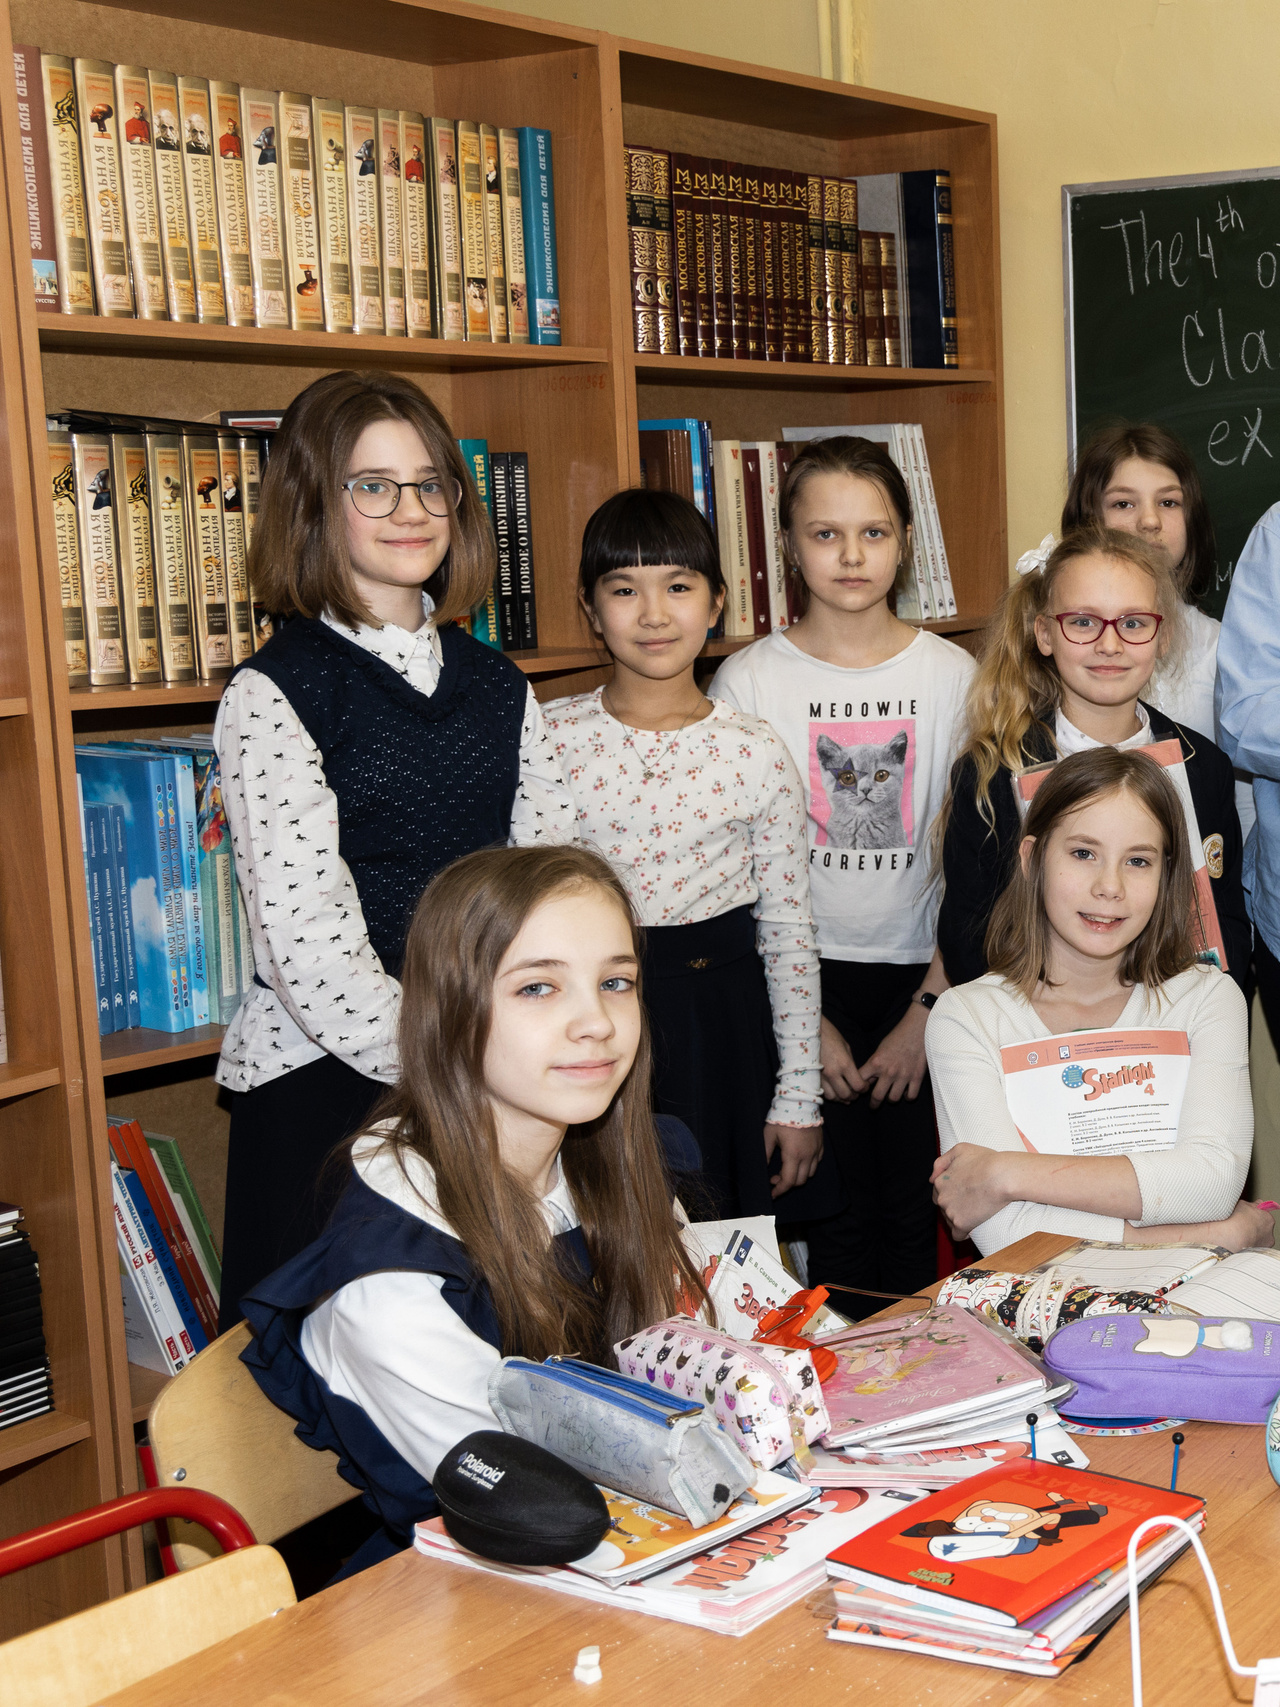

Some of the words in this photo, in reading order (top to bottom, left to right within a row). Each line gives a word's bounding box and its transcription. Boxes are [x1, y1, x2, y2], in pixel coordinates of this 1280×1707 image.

[13, 52, 28, 97] ДЕТЕЙ
[18, 102, 31, 131] ДЛЯ
[536, 135, 546, 171] ДЕТЕЙ
[22, 136, 42, 250] ЭНЦИКЛОПЕДИЯ
[58, 139, 75, 229] ШКОЛЬНАЯ
[95, 145, 112, 233] ШКОЛЬНАЯ
[131, 147, 147, 235] ШКОЛЬНАЯ
[161, 153, 177, 239] ШКОЛЬНАЯ
[191, 157, 207, 242] ШКОЛЬНАЯ
[223, 161, 239, 247] ШКОЛЬНАЯ
[538, 174, 548, 198] ДЛЯ
[256, 168, 270, 252] ШКОЛЬНАЯ
[301, 177, 315, 259] ШКОЛЬНАЯ
[324, 175, 340, 256] ШКОЛЬНАЯ
[356, 179, 370, 259] ШКОЛЬНАЯ
[385, 186, 396, 257] ШКОЛЬНАЯ
[408, 185, 420, 263] ШКОЛЬНАЯ
[442, 193, 454, 262] ШКОЛЬНАЯ
[475, 200, 485, 275] ШКОЛЬНАЯ
[488, 200, 499, 267] ШКОЛЬНАЯ
[515, 207, 524, 274] ШКОЛЬНАЯ
[541, 201, 555, 294] ЭНЦИКЛОПЕДИЯ
[676, 209, 689, 291] МОСКОВСКАЯ
[695, 213, 707, 294] МОСКОВСКАЯ
[712, 213, 724, 294] МОСКОВСКАЯ
[729, 215, 741, 295] МОСКОВСКАЯ
[745, 217, 756, 296] МОСКОВСКАЯ
[1100, 209, 1189, 295] The
[763, 221, 774, 299] МОСКОВСКАЯ
[780, 221, 791, 299] МОСКОВСКАЯ
[795, 223, 806, 300] МОСКОВСКАЯ
[473, 454, 487, 496] ДЕТЕЙ
[734, 478, 742, 508] МОСКВА
[494, 466, 508, 535] ПУШКИНЕ
[514, 465, 528, 534] ПУШКИНЕ
[56, 513, 72, 600] ШКОЛЬНАЯ
[90, 513, 107, 600] ШКОЛЬНАЯ
[132, 515, 147, 600] ШКОЛЬНАЯ
[163, 514, 179, 598] ШКОЛЬНАЯ
[200, 515, 216, 598] ШКОЛЬНАЯ
[227, 518, 241, 592] ШКОЛЬНАЯ
[499, 537, 509, 548] О
[518, 536, 528, 547] О
[736, 510, 745, 567] ПРАВОСЛАВНАЯ
[500, 550, 512, 596] НОВОЕ
[518, 548, 531, 594] НОВОЕ
[809, 699, 917, 718] MEOOWIE
[157, 828, 168, 852] МИРЕ
[159, 854, 169, 864] О
[167, 826, 177, 850] МИРЕ
[185, 821, 196, 853] Земля!
[809, 848, 915, 871] FOREVER
[91, 871, 102, 901] Пушкина
[103, 867, 114, 897] Пушкина
[118, 865, 129, 895] Пушкина
[161, 866, 172, 892] КНИГА
[171, 863, 181, 889] КНИГА
[188, 854, 198, 891] планете
[222, 858, 232, 917] ХУДОЖНИКИ
[163, 895, 176, 935] ГЛАВНАЯ
[173, 892, 185, 931] ГЛАВНАЯ
[191, 892, 199, 903] на
[191, 904, 202, 923] мир
[166, 936, 178, 968] САМАЯ
[176, 934, 188, 965] САМАЯ
[192, 924, 200, 936] за
[192, 936, 205, 971] голосую
[194, 971, 205, 983] Я
[1082, 1061, 1156, 1102] Starlight
[1143, 1083, 1155, 1096] 4
[113, 1170, 128, 1199] ЧТЕНИЕ
[113, 1202, 125, 1224] ЯЗЫК
[124, 1197, 150, 1249] ЛИТЕРАТУРНОЕ
[120, 1223, 138, 1255] РУССКИЙ
[140, 1268, 157, 1303] Желтовская
[759, 1266, 779, 1288] Сахаров
[168, 1344, 181, 1360] Часть
[182, 1338, 193, 1354] Часть
[461, 1451, 505, 1484] Polaroid
